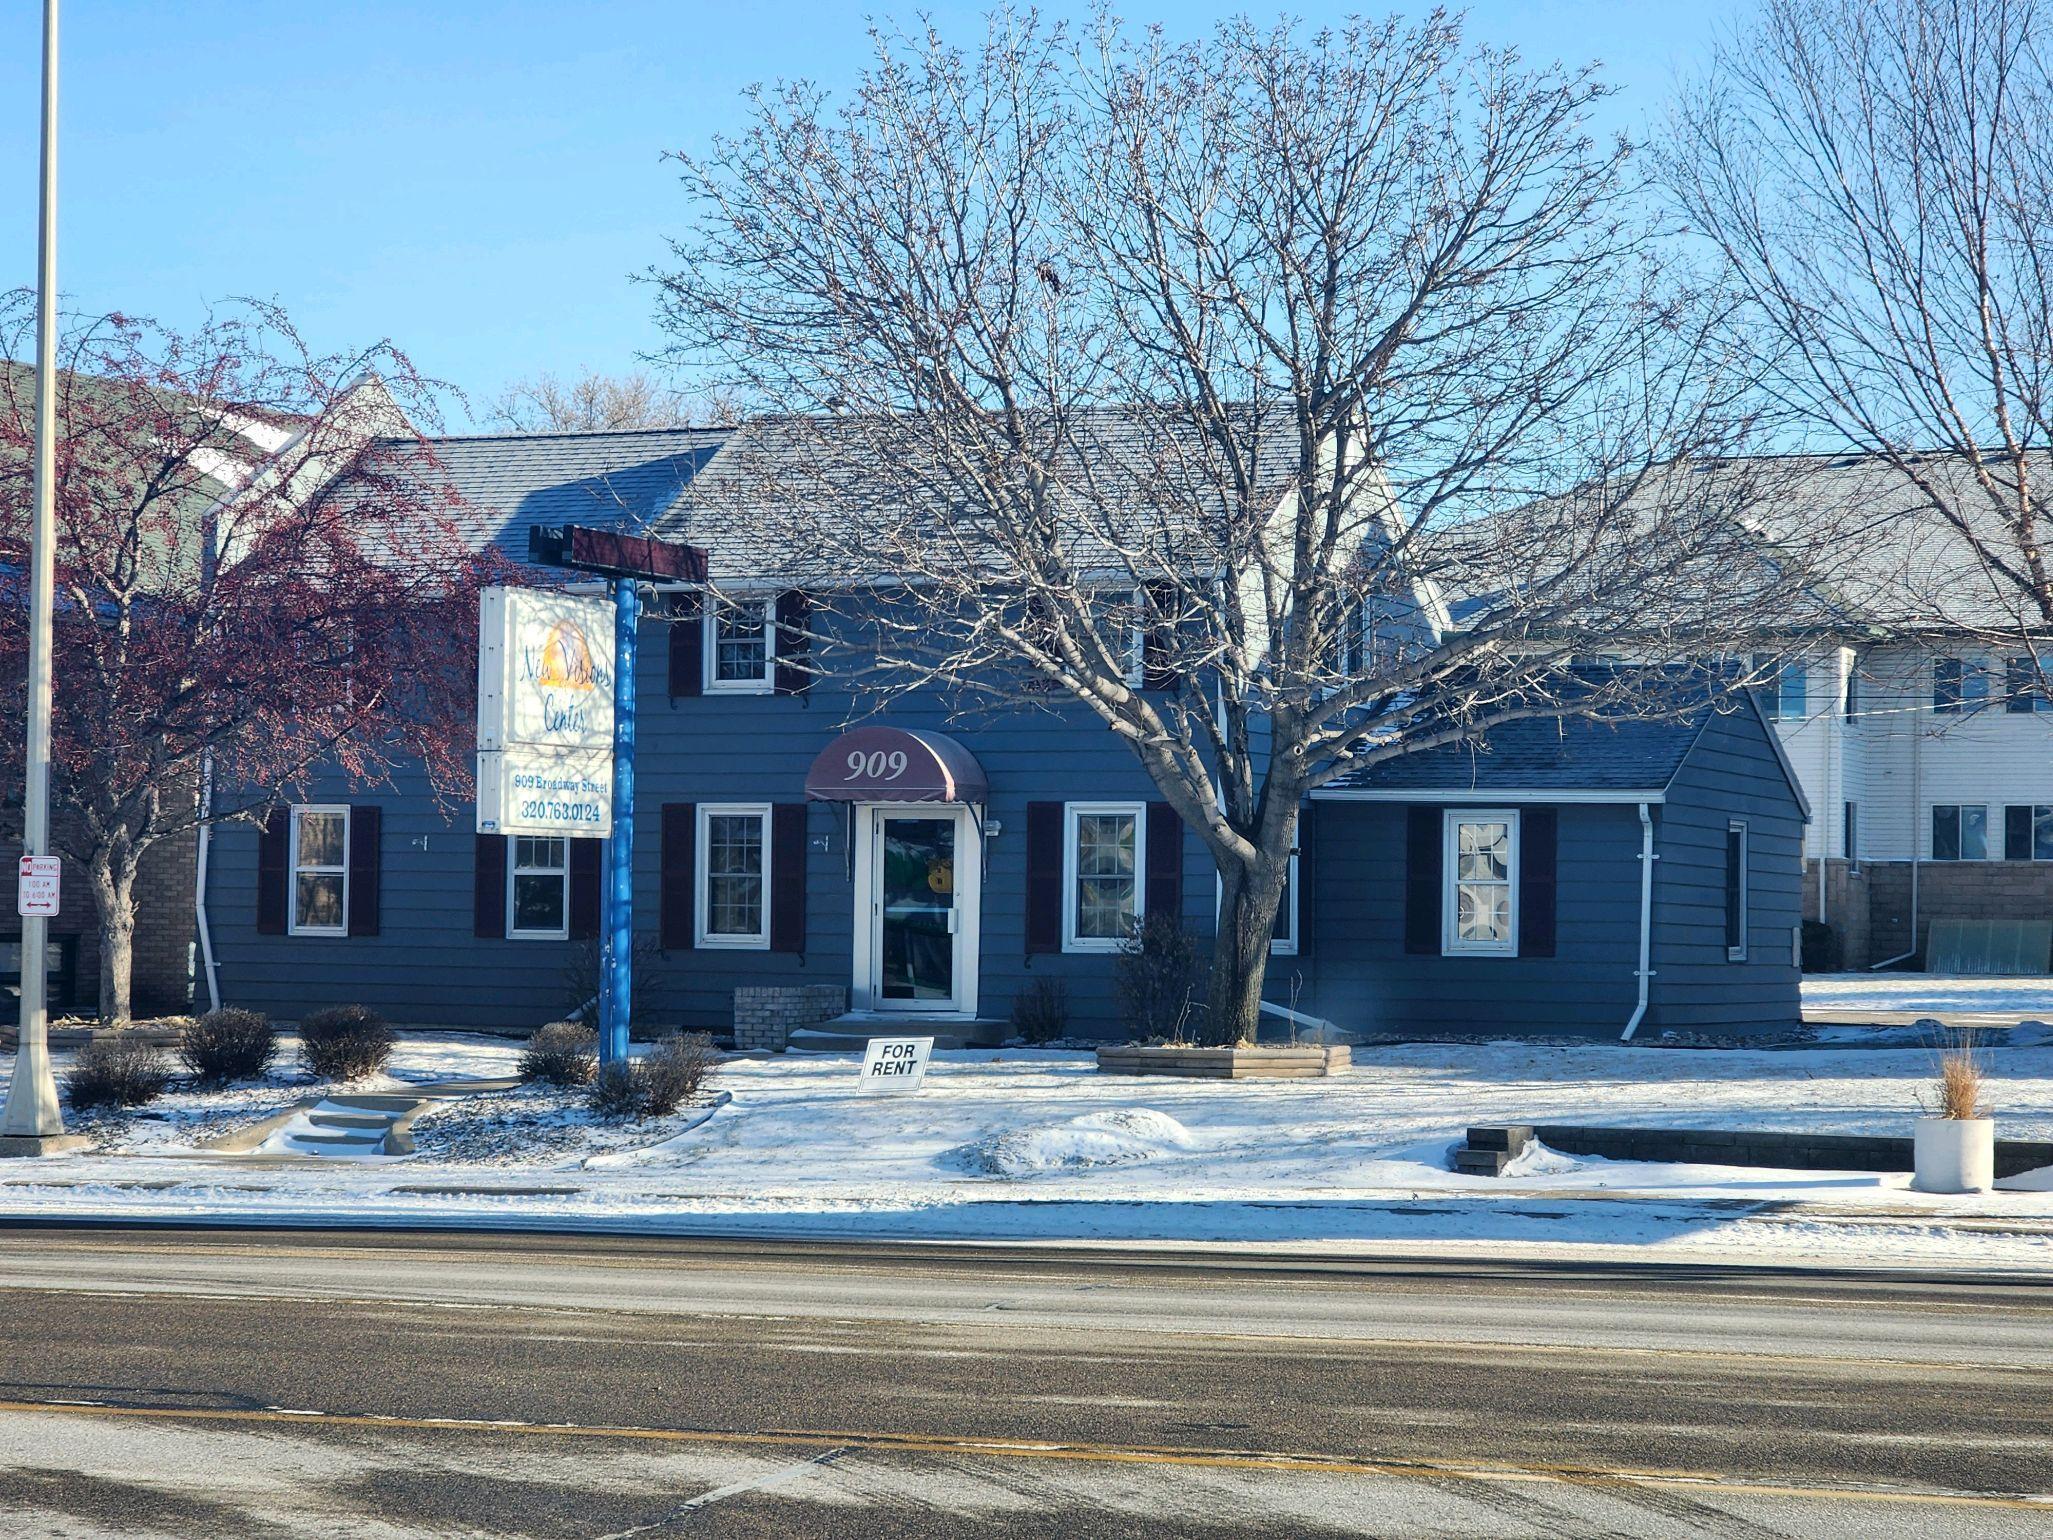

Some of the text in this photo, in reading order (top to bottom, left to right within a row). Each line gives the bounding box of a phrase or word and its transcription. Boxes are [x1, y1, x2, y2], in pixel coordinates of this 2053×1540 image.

[520, 640, 611, 686] New Visions
[544, 693, 587, 733] Center
[844, 751, 907, 781] 909
[515, 774, 607, 795] 909 Broadway Street
[521, 800, 600, 821] 320.763.0124
[32, 863, 57, 871] PARKING
[881, 1044, 915, 1059] FOR
[871, 1060, 917, 1076] RENT
